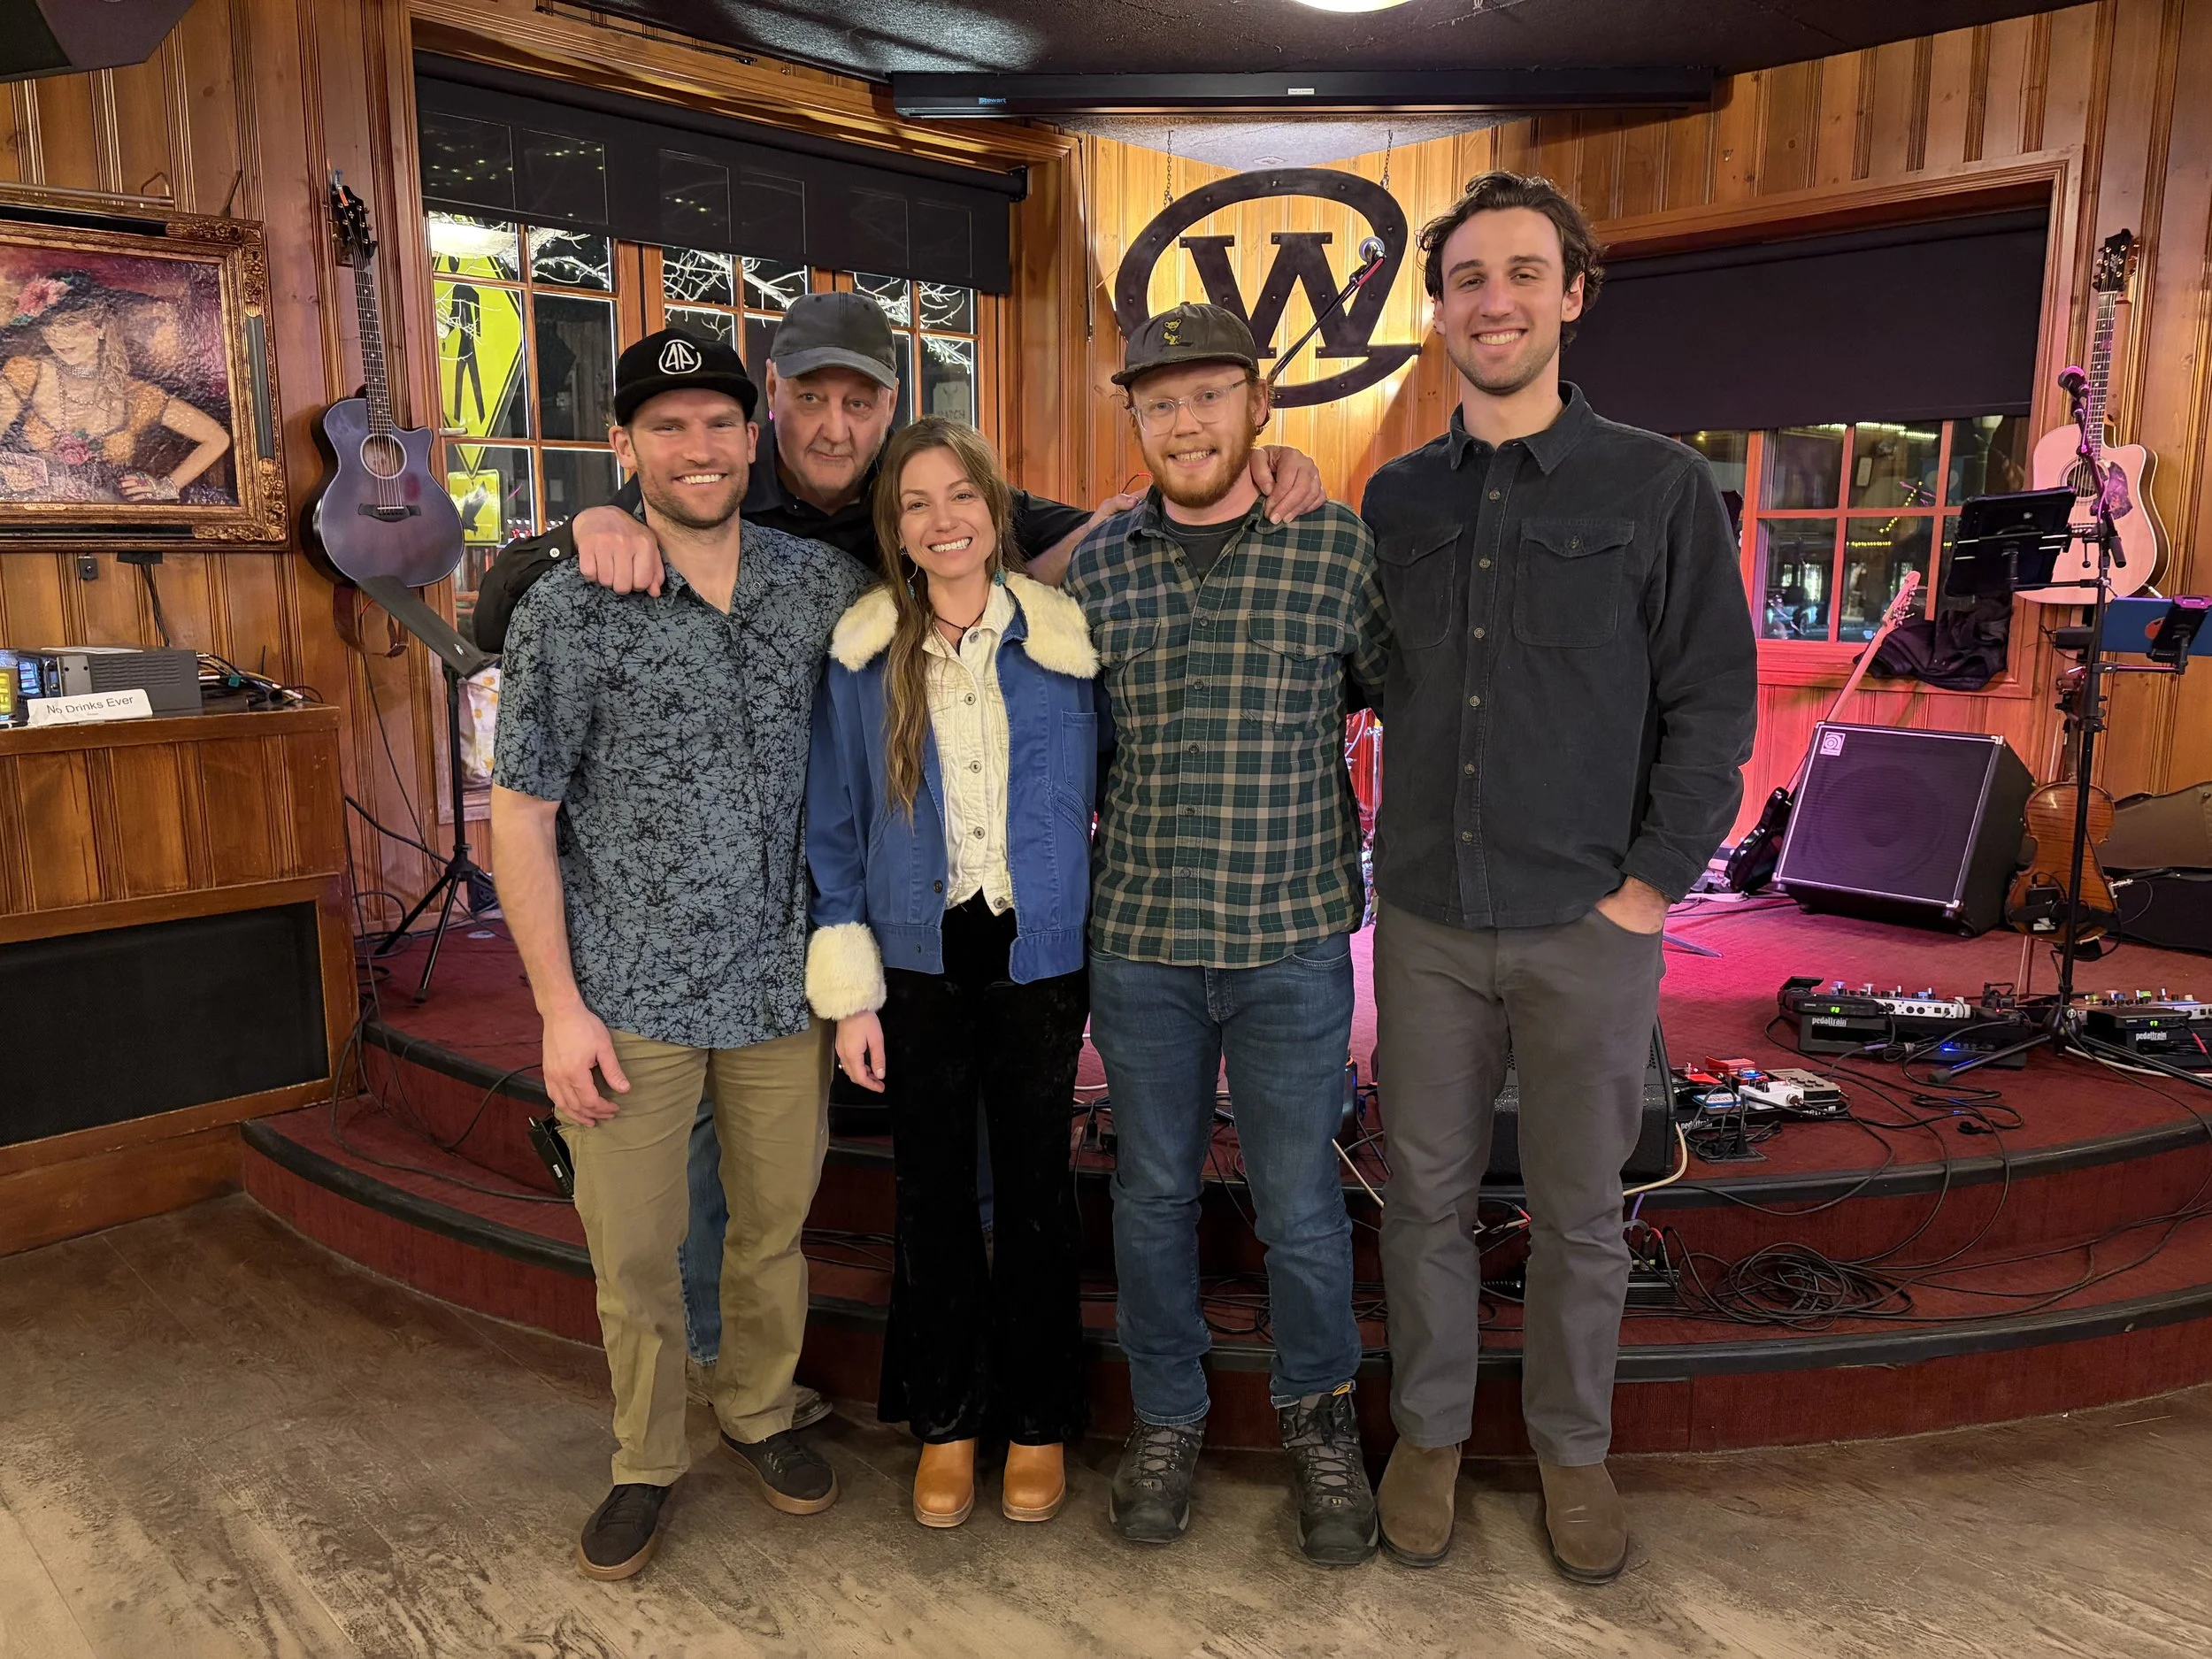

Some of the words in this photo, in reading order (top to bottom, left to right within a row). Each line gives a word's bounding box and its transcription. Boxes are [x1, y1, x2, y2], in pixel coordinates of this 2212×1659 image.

[47, 704, 63, 714] No
[65, 701, 104, 713] Drinks
[106, 696, 134, 708] Ever
